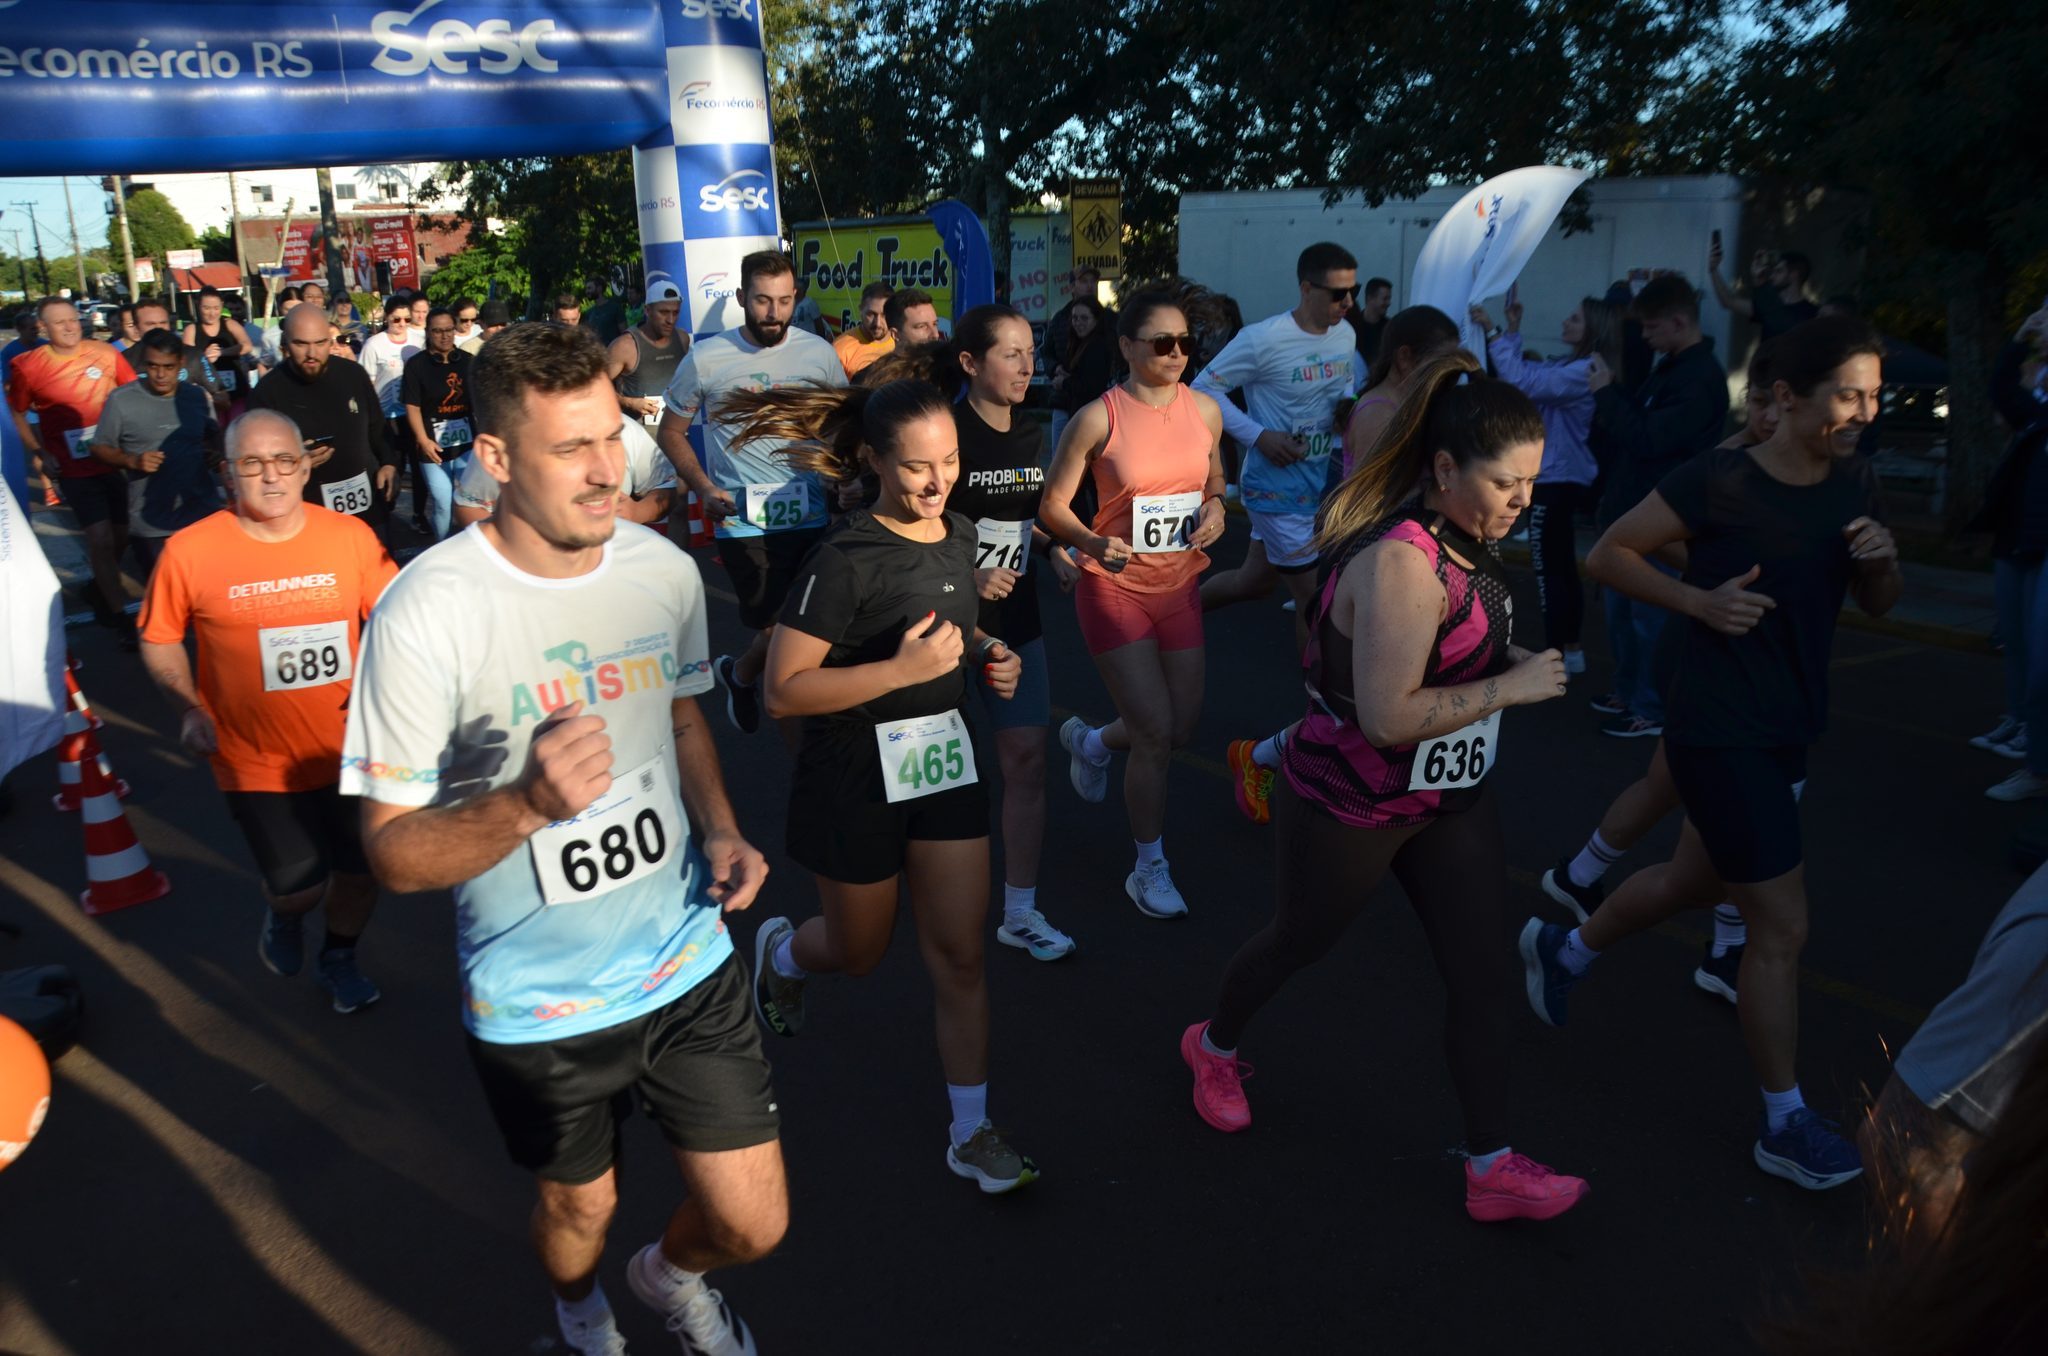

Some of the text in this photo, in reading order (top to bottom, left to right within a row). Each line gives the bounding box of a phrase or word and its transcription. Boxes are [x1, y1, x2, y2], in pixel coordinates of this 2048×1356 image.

[370, 10, 559, 77] Sesc
[252, 41, 313, 78] RS
[686, 97, 754, 110] Fecomércio
[660, 197, 675, 209] RS
[699, 184, 770, 213] Sesc
[1075, 183, 1118, 195] DEVAGAR
[1010, 233, 1046, 251] ruck
[802, 239, 863, 290] Food
[876, 237, 949, 288] Truck
[1077, 254, 1119, 269] ELEVADA
[441, 429, 469, 446] 540
[333, 487, 369, 513] 683
[987, 483, 1040, 495] MADE FOR YOU
[756, 499, 802, 526] 425
[1144, 514, 1195, 548] 670
[1531, 504, 1548, 570] GROWTH
[975, 541, 1025, 572] 716
[228, 573, 337, 600] DETRUNNERS
[276, 645, 340, 684] 689
[898, 738, 964, 790] 465
[1423, 736, 1486, 784] 636
[561, 807, 666, 892] 680
[763, 1001, 787, 1034] FILA
